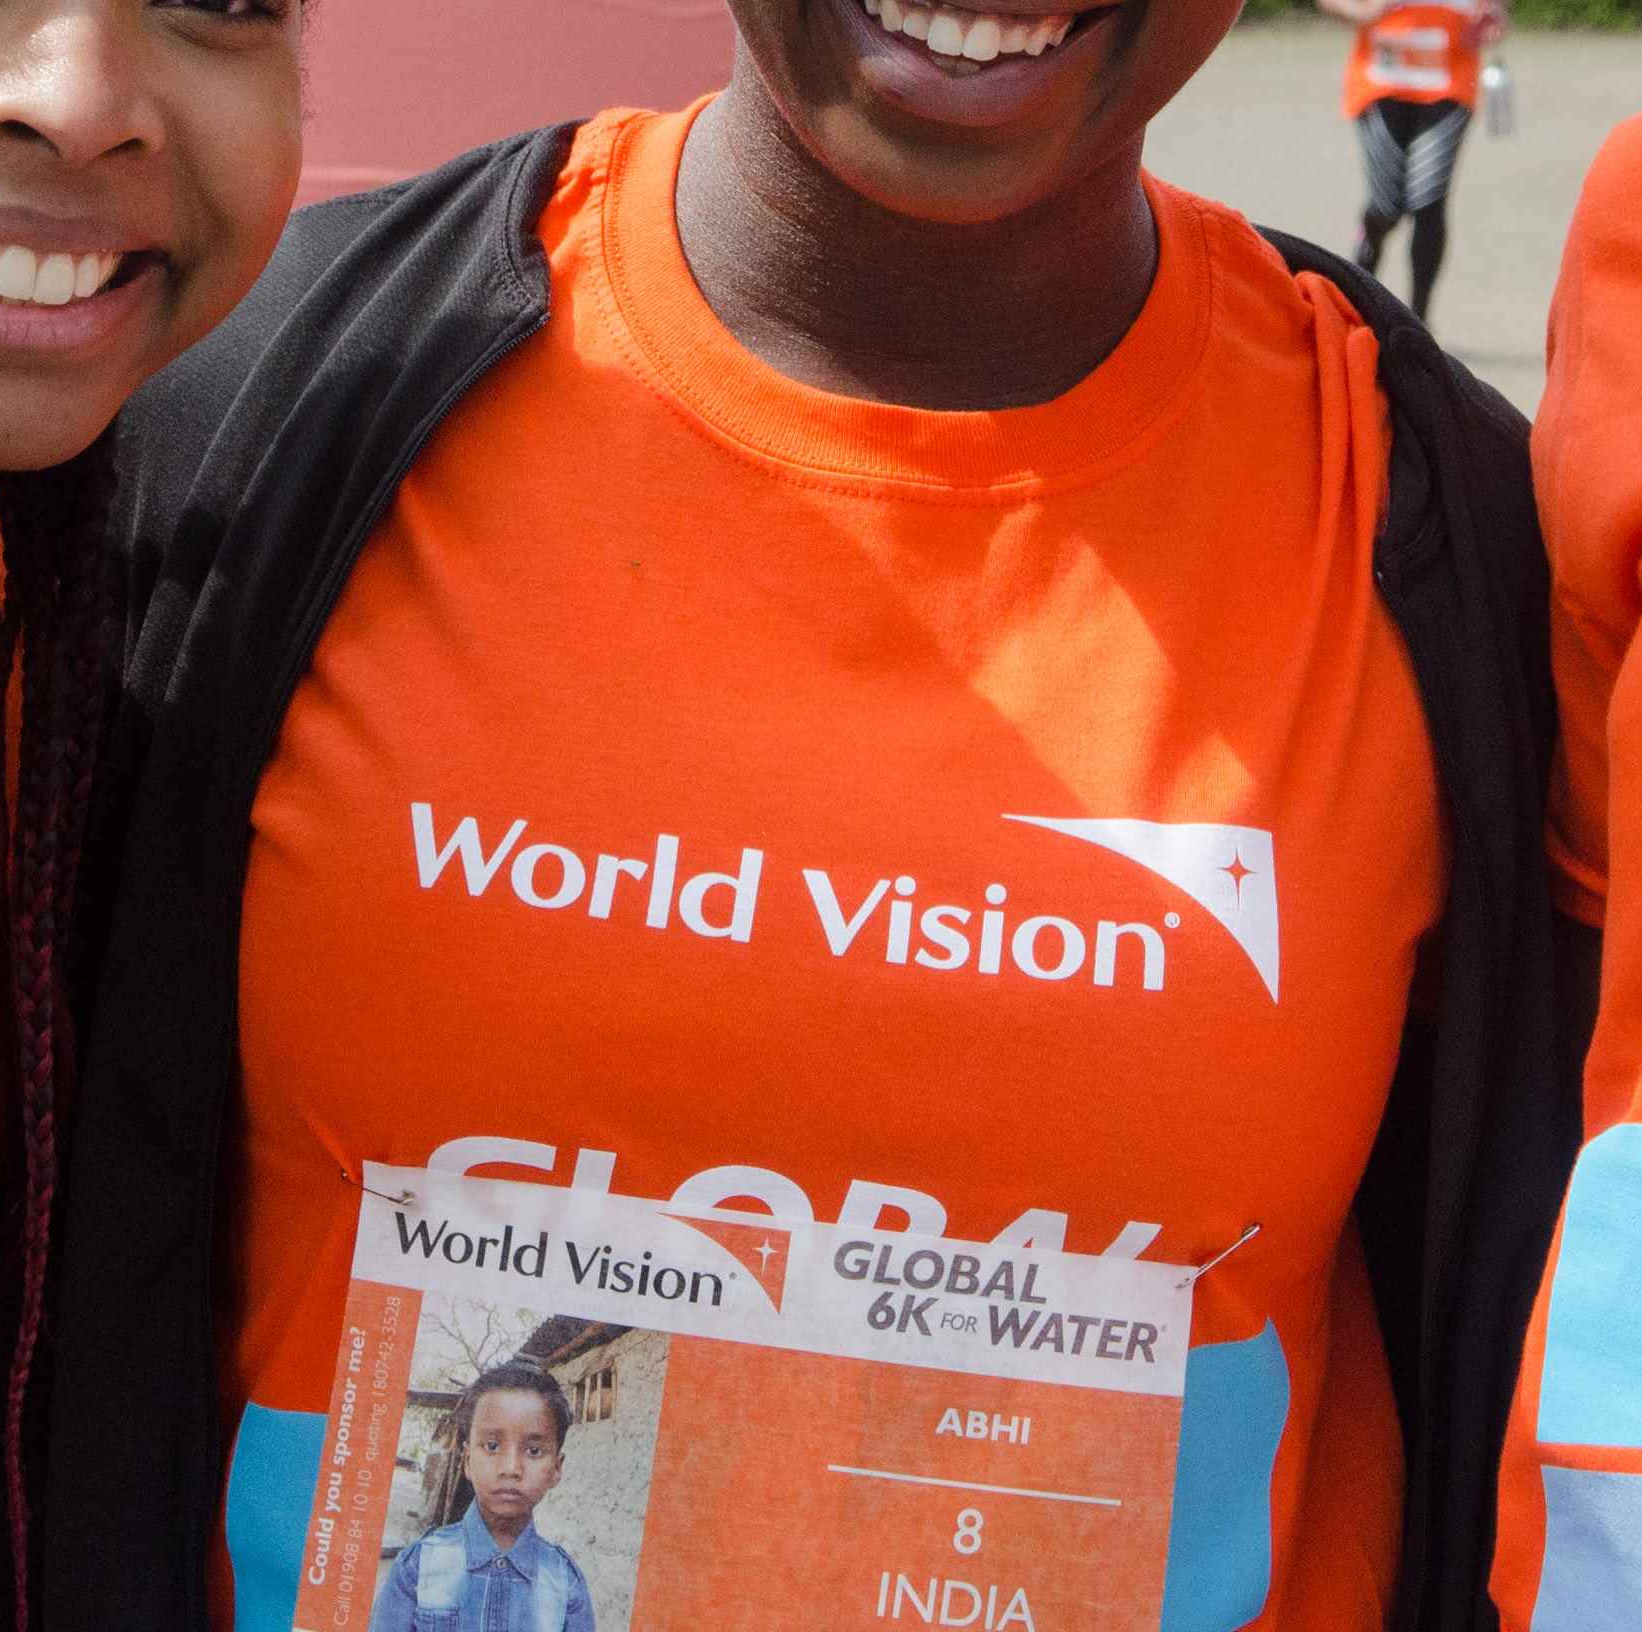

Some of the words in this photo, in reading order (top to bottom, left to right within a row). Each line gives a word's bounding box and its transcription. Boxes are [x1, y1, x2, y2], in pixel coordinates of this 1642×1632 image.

[410, 801, 764, 943] World
[395, 1211, 549, 1279] World
[833, 1240, 1048, 1306] GLOBAL
[348, 1326, 367, 1372] me?
[866, 1290, 939, 1338] 6K
[940, 1311, 978, 1334] FOR
[987, 1304, 1159, 1364] WATER
[332, 1377, 360, 1467] sponsor
[935, 1407, 1032, 1446] ABHI
[324, 1471, 343, 1513] you
[333, 1592, 353, 1627] Call
[365, 1402, 388, 1462] quoting
[308, 1516, 335, 1586] Could
[952, 1507, 985, 1556] 8
[875, 1570, 1037, 1632] INDIA
